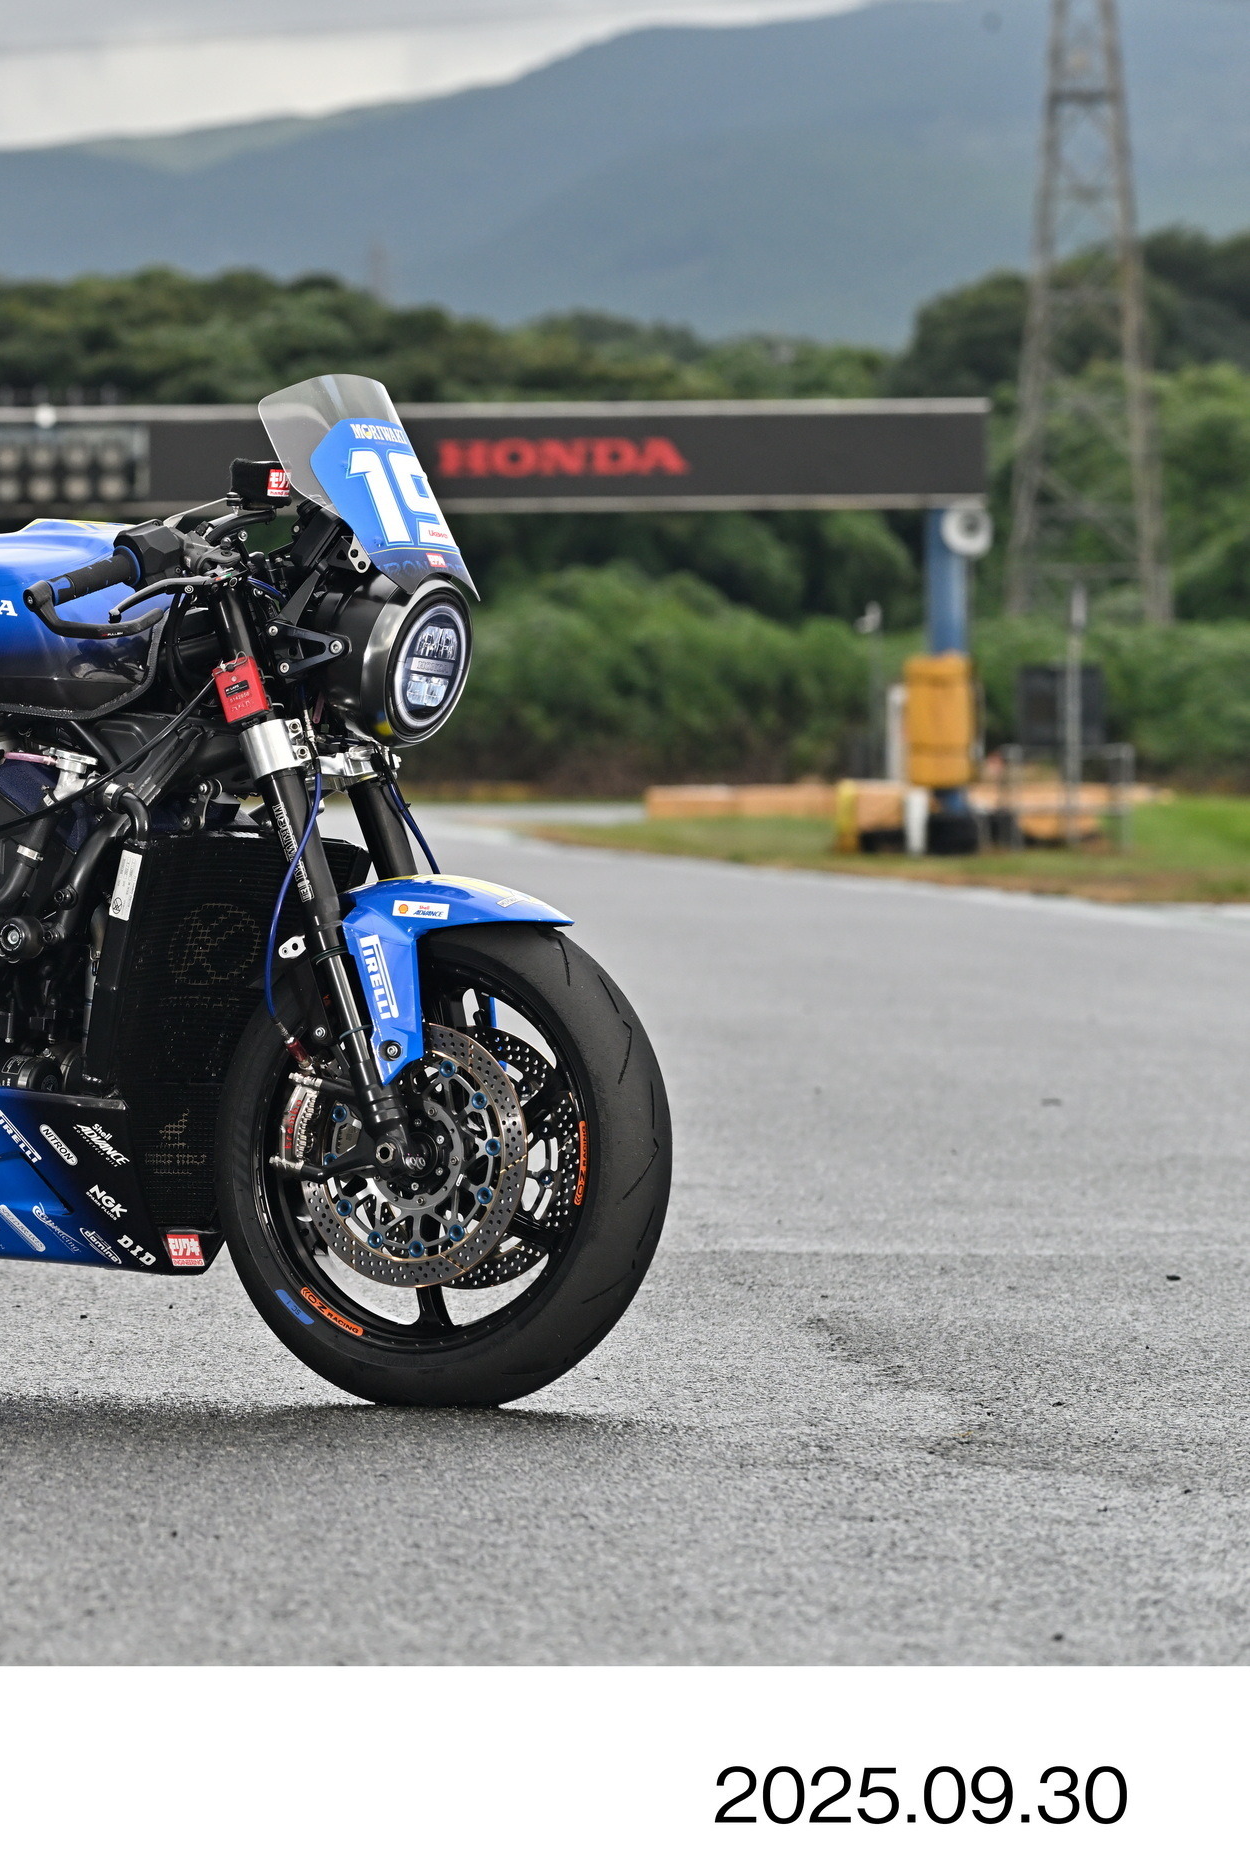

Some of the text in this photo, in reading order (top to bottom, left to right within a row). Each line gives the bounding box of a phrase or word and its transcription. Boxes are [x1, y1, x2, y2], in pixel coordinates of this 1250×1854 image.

[438, 436, 687, 478] HONDA
[347, 449, 458, 549] 19
[272, 801, 308, 882] MORIWKI
[359, 934, 399, 1020] PIRELLI
[76, 1124, 130, 1166] ADVANCE
[91, 1123, 113, 1141] Shell
[88, 1184, 128, 1218] NGK
[84, 1228, 119, 1263] domino
[167, 1238, 201, 1257] モリワキ
[326, 1311, 359, 1334] RACING
